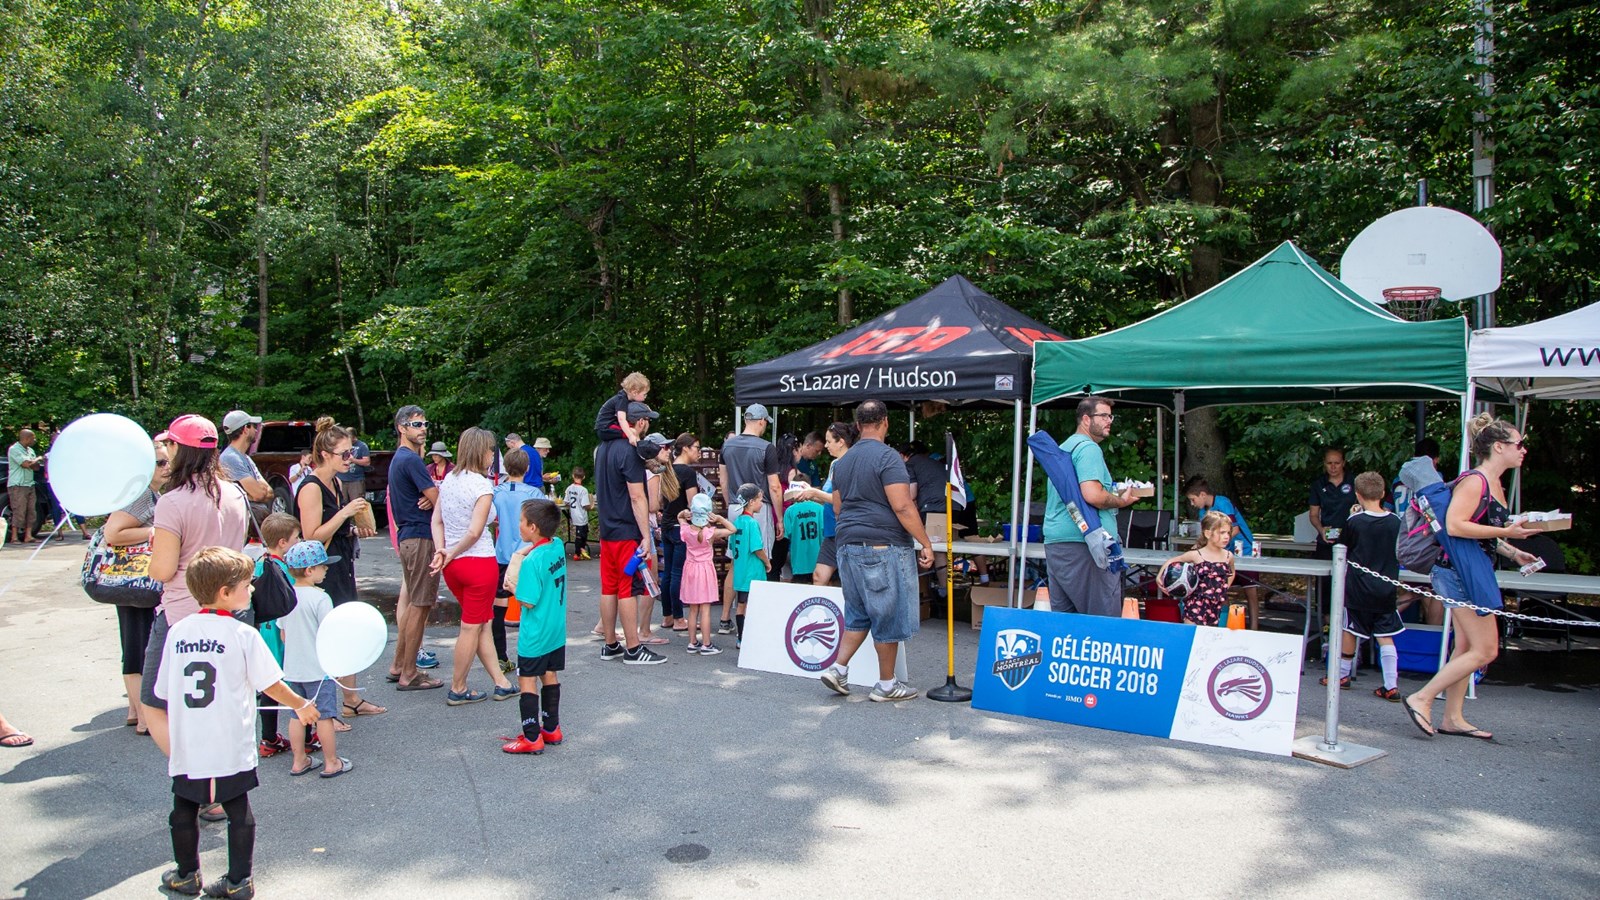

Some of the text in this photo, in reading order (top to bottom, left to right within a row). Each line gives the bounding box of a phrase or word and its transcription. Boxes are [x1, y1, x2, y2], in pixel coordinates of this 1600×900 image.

[779, 365, 957, 393] St-Lazare / Hudson
[570, 496, 577, 509] 2
[799, 521, 818, 541] 18
[175, 639, 226, 654] timbits
[1051, 634, 1164, 670] CÉLÉBRATION
[184, 661, 217, 708] 3
[1047, 661, 1112, 690] SOCCER
[1115, 669, 1159, 696] 2018
[1065, 695, 1083, 704] BMO
